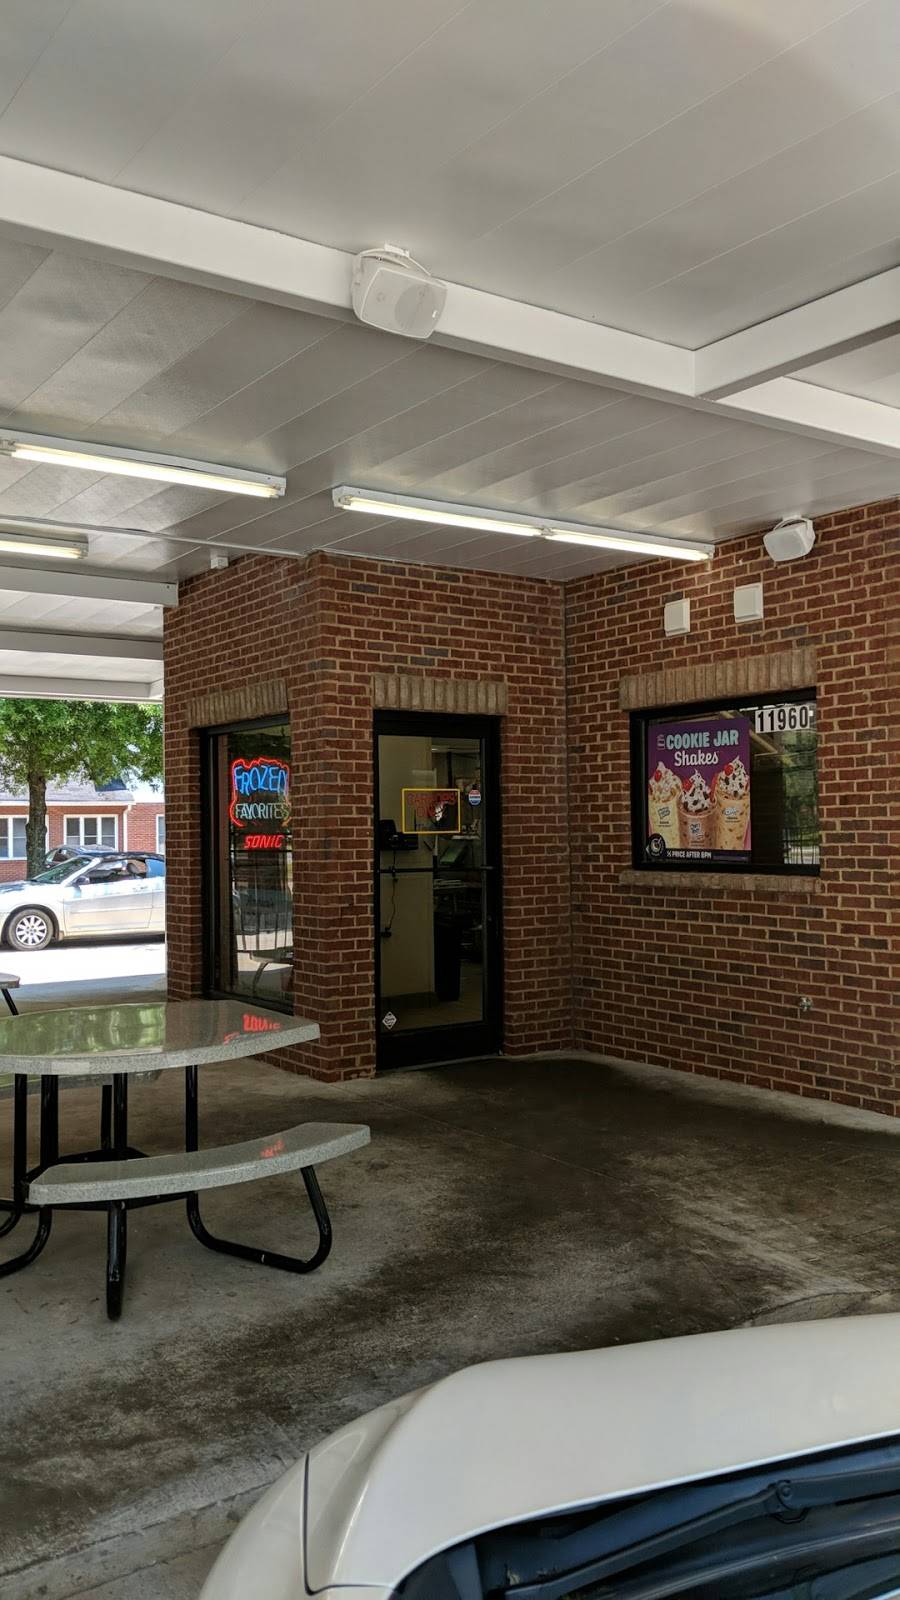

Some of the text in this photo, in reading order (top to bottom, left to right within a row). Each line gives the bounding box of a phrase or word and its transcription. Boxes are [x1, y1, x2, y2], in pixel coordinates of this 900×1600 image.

[757, 705, 809, 732] 11960
[666, 731, 710, 750] COOKIE
[713, 729, 739, 747] JAR
[674, 750, 719, 767] Shakes
[234, 765, 289, 796] FROZEN
[235, 802, 290, 819] FAVORITES
[244, 834, 285, 849] SONIC
